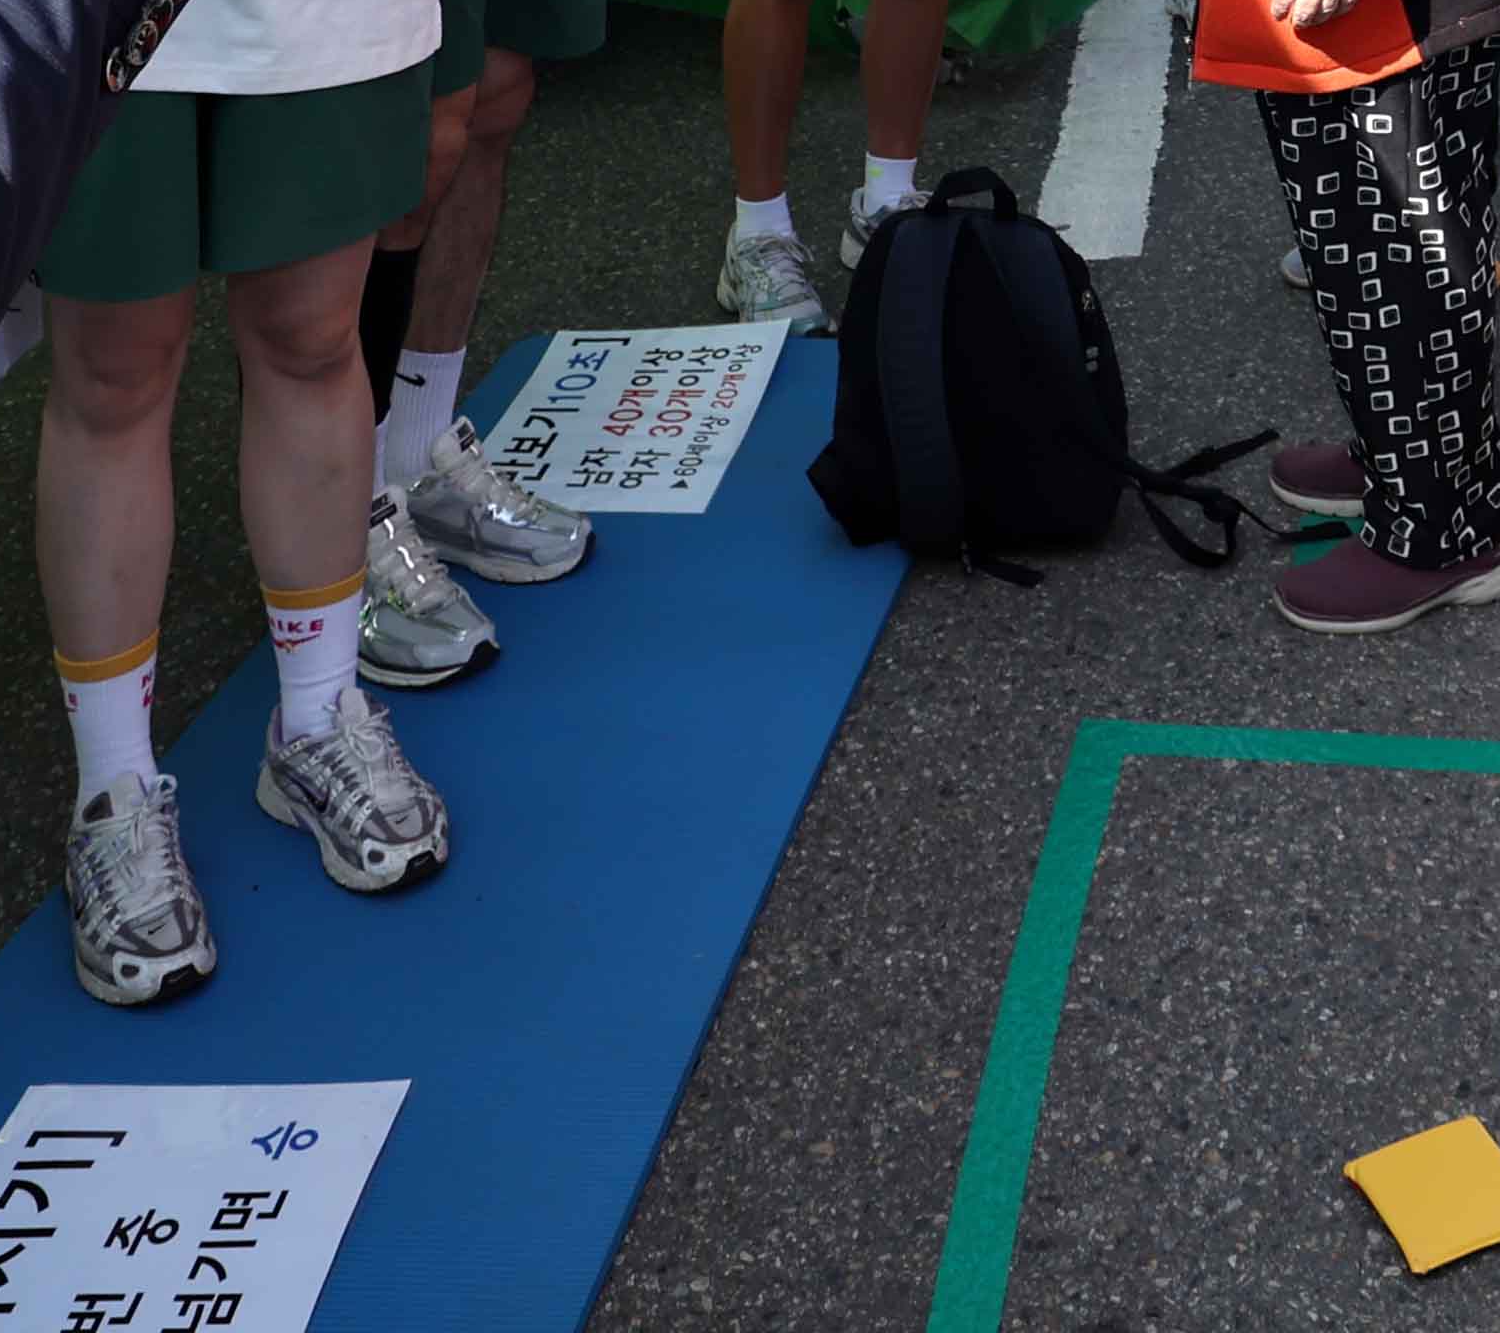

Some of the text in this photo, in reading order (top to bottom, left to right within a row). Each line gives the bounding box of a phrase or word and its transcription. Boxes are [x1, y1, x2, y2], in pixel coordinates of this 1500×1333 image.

[565, 346, 686, 490] 남자 40개이상
[618, 344, 732, 490] 여자 30개이상
[251, 1120, 320, 1161] 승
[105, 1209, 180, 1256] 중
